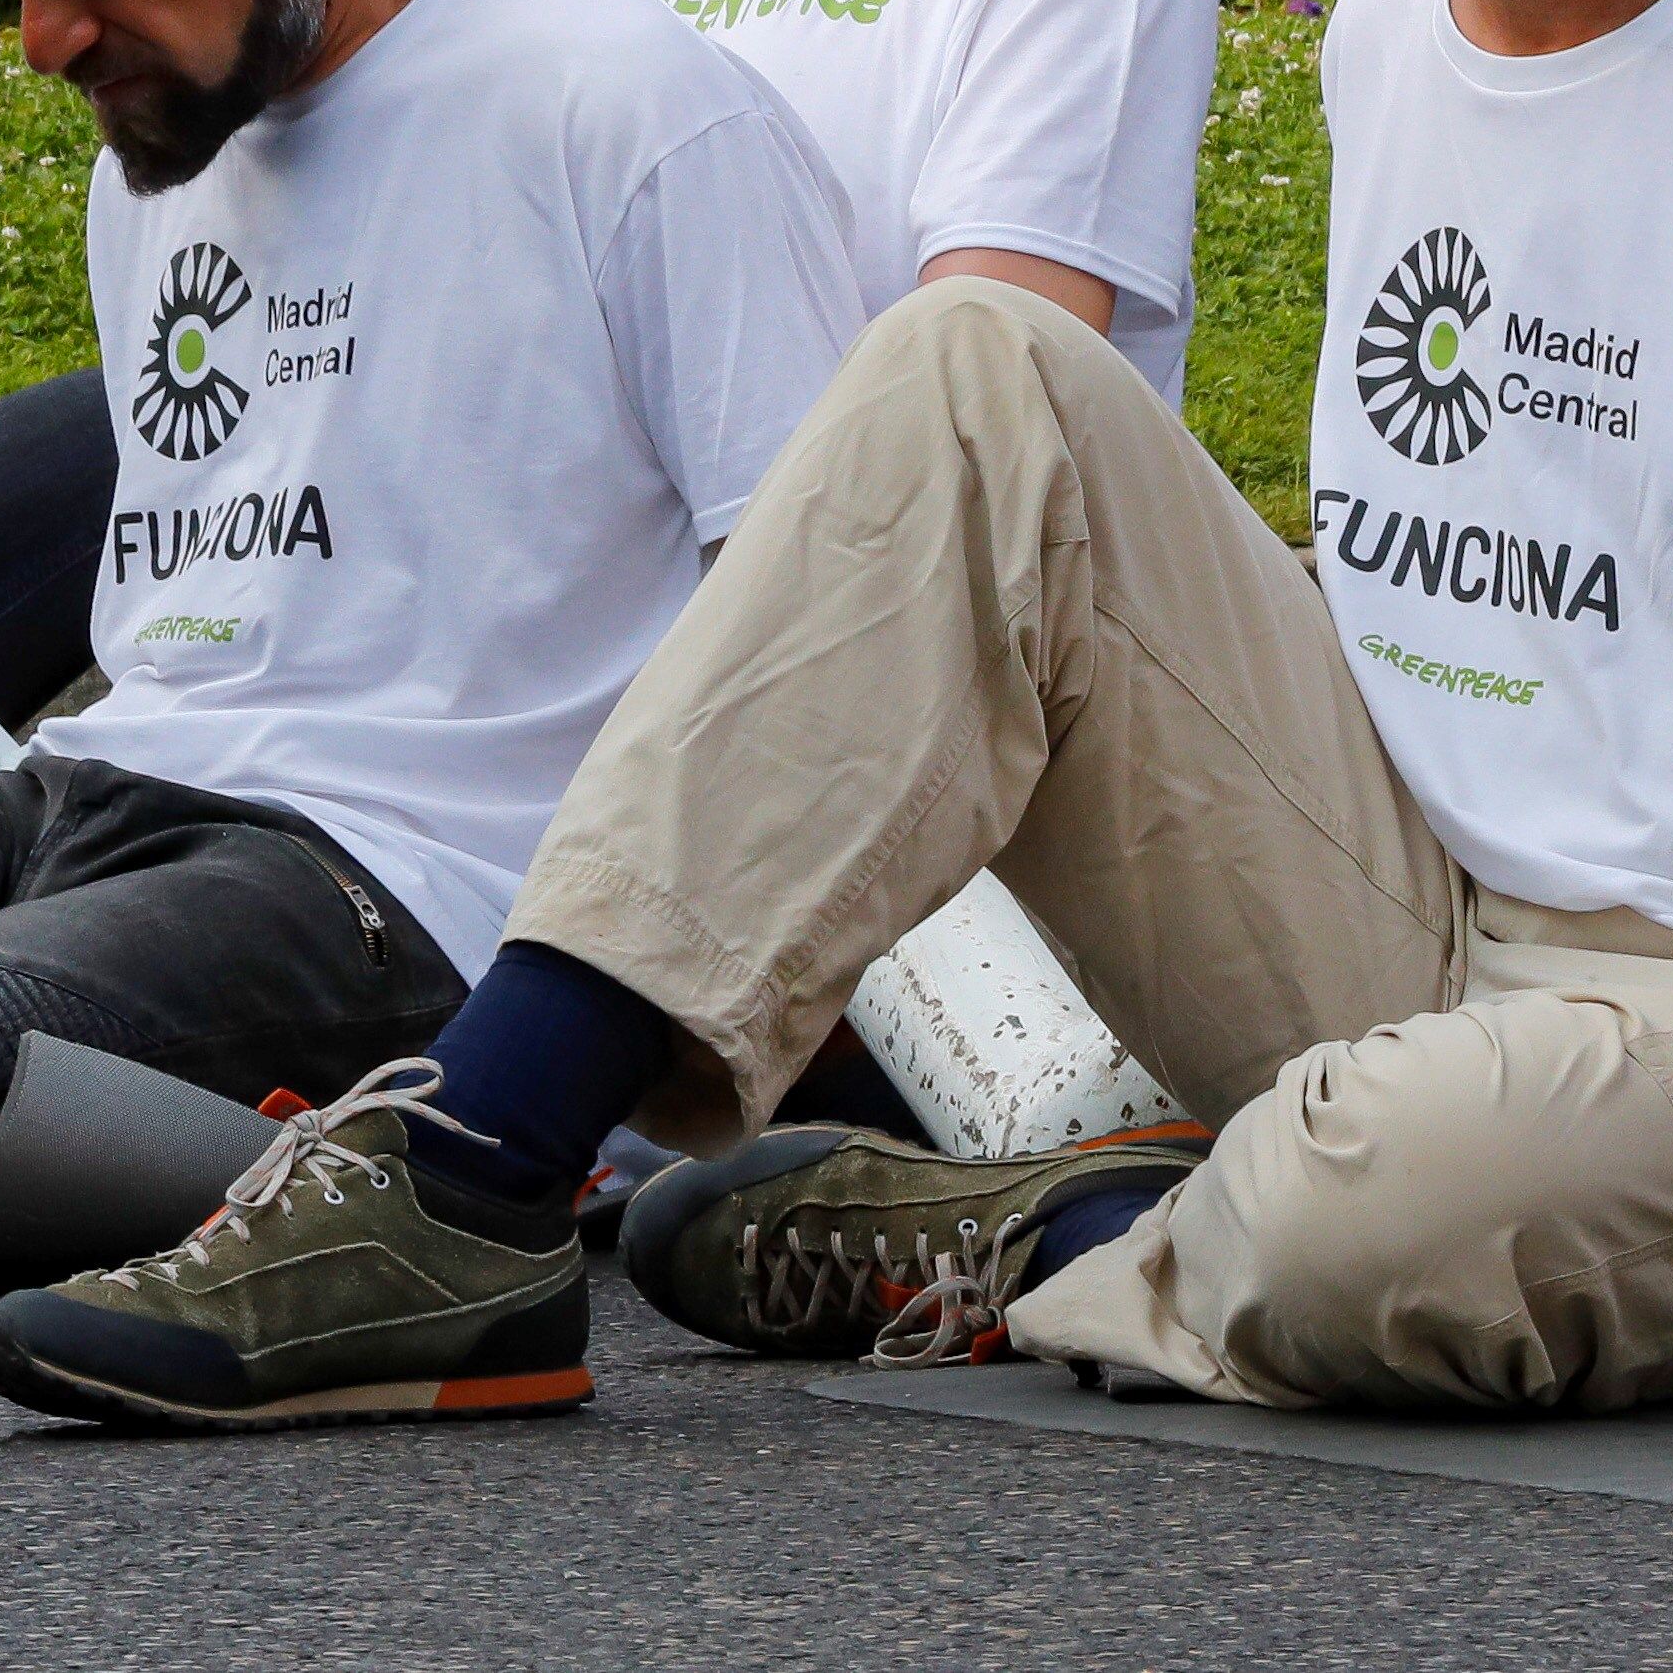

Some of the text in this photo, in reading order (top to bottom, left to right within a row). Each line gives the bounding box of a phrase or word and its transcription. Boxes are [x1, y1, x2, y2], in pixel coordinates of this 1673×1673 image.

[267, 282, 353, 333] Madrid
[265, 337, 356, 386] Central
[1504, 312, 1639, 380] Madrid
[1498, 373, 1638, 440] Central
[1315, 490, 1620, 632] FUNCIONA
[1358, 633, 1544, 706] GREENPEACE
